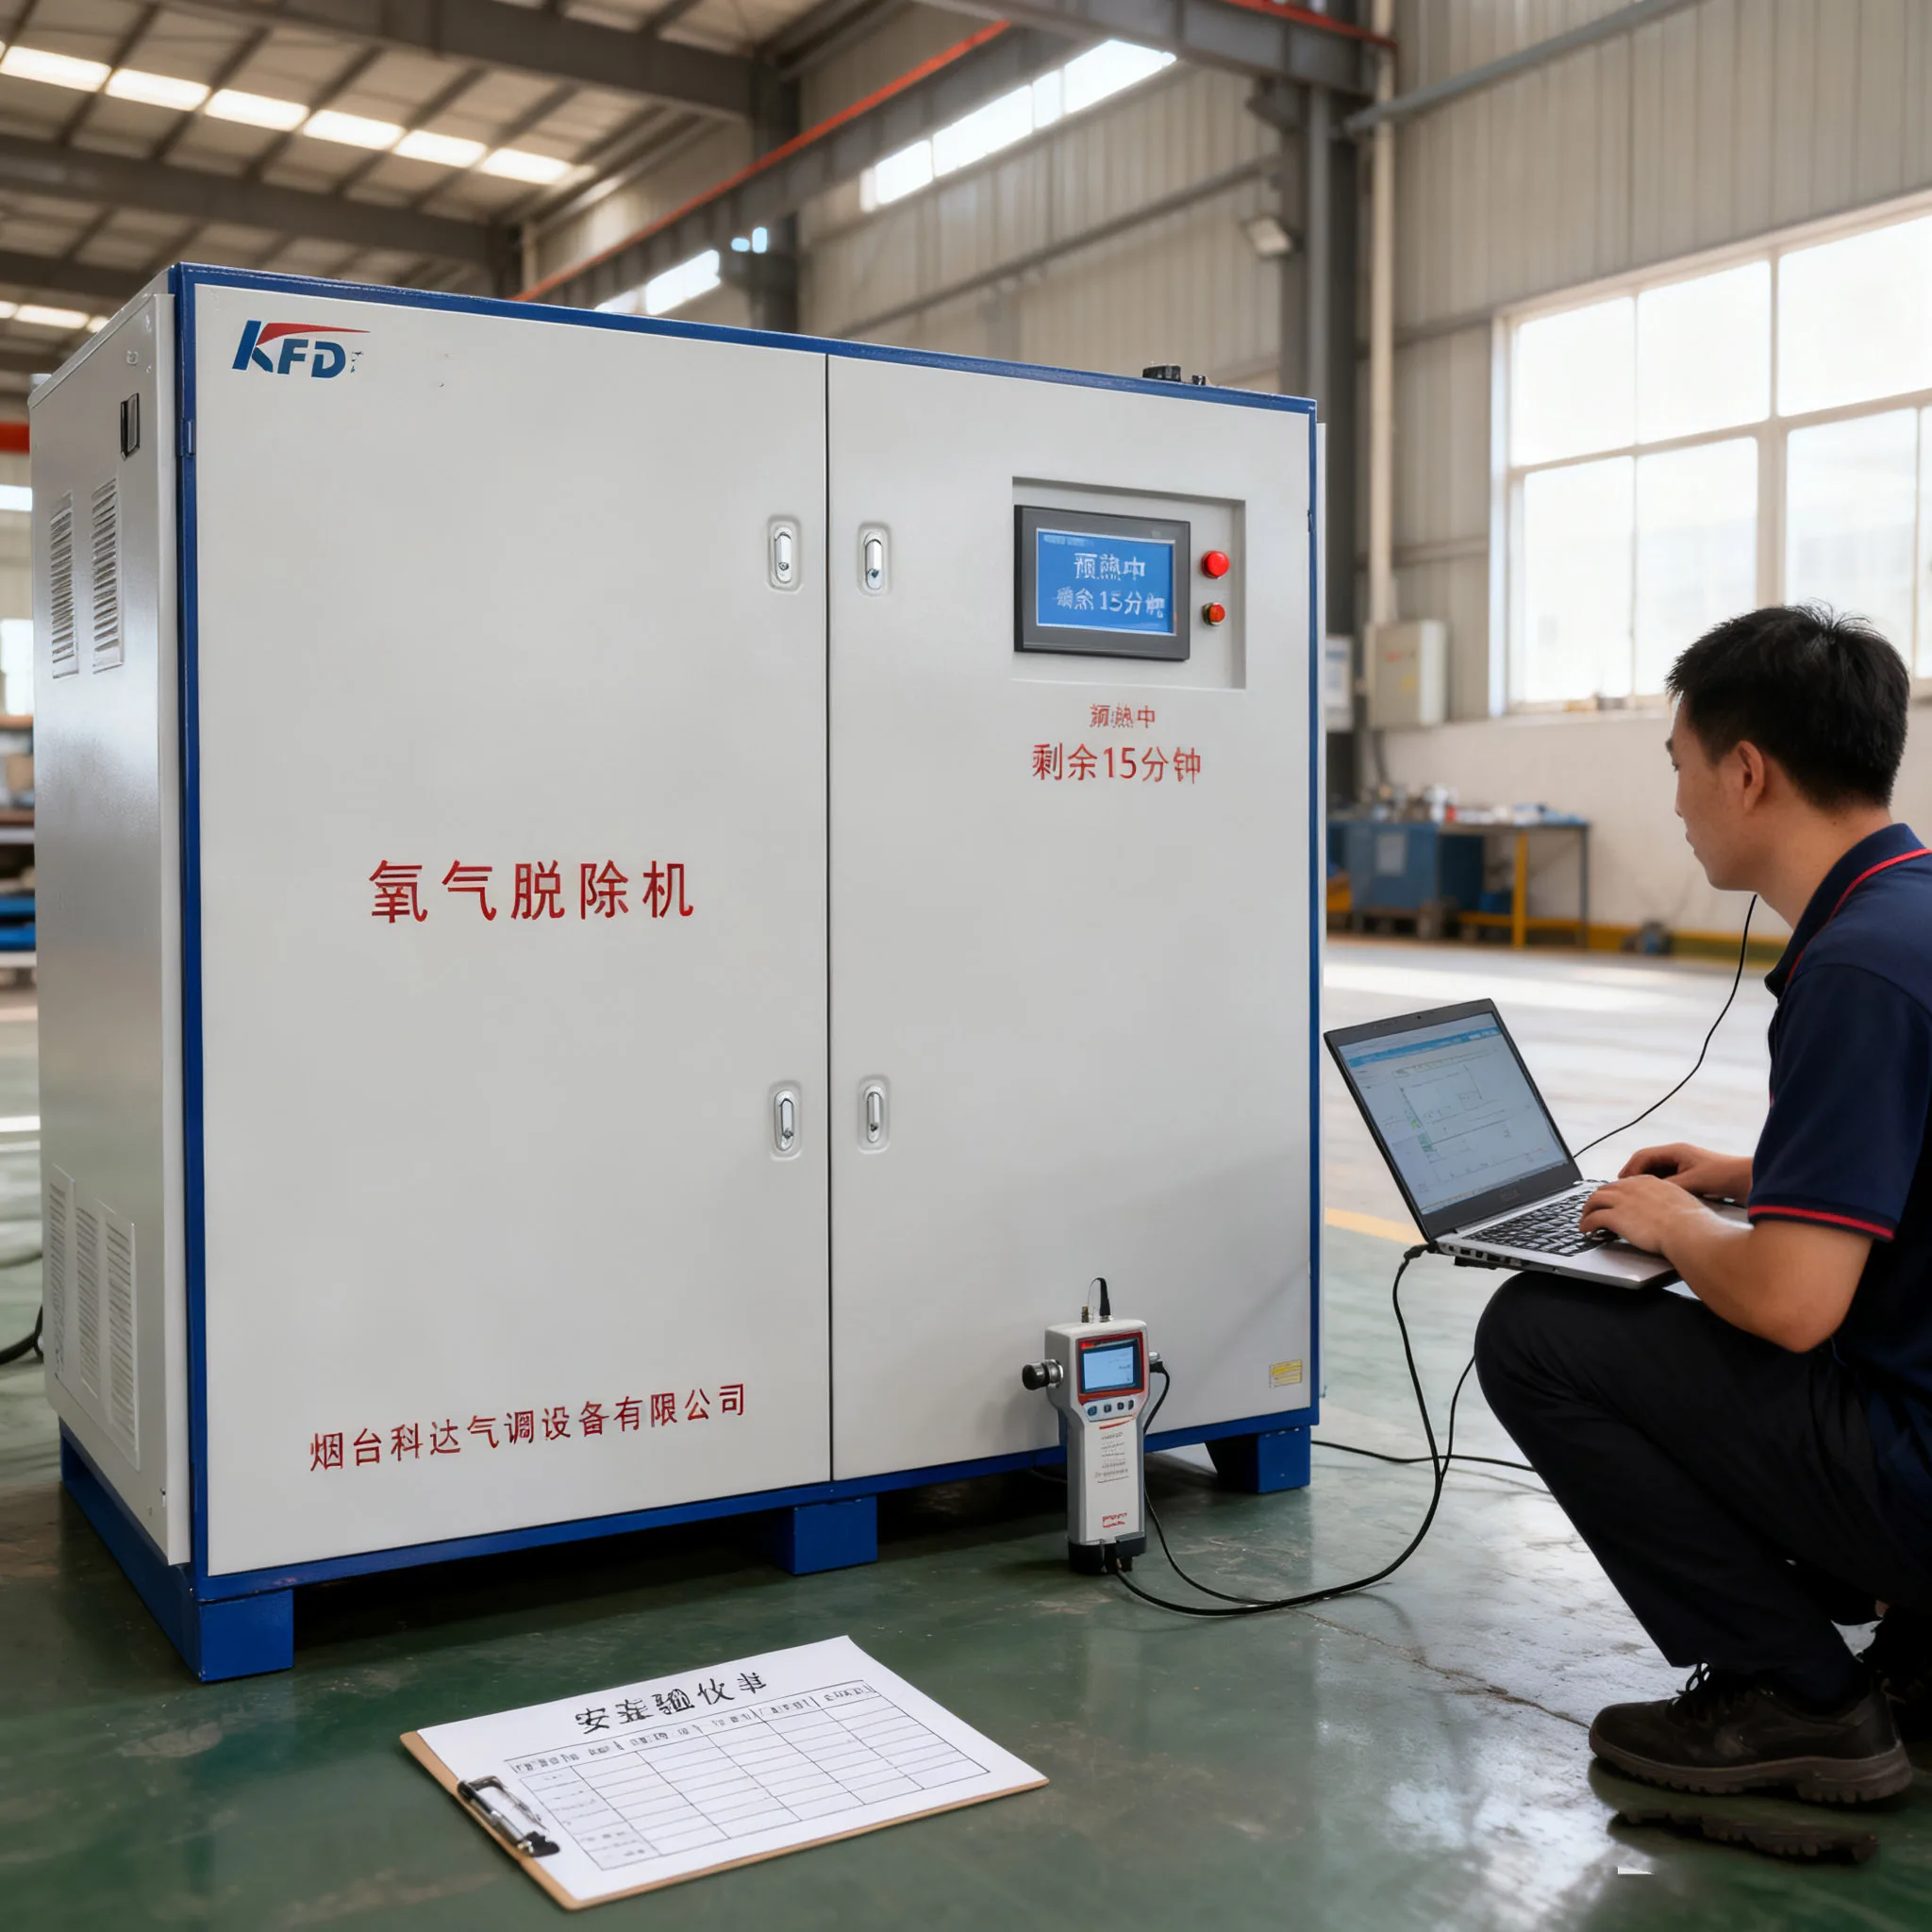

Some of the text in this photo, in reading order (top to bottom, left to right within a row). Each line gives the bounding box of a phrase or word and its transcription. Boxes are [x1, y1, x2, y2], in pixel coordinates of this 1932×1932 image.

[232, 320, 371, 378] KFD
[1032, 742, 1202, 784] 剩余15分钟
[369, 859, 694, 924] 氧气脱除机
[309, 1383, 745, 1472] 烟台科达气调设备有限公司
